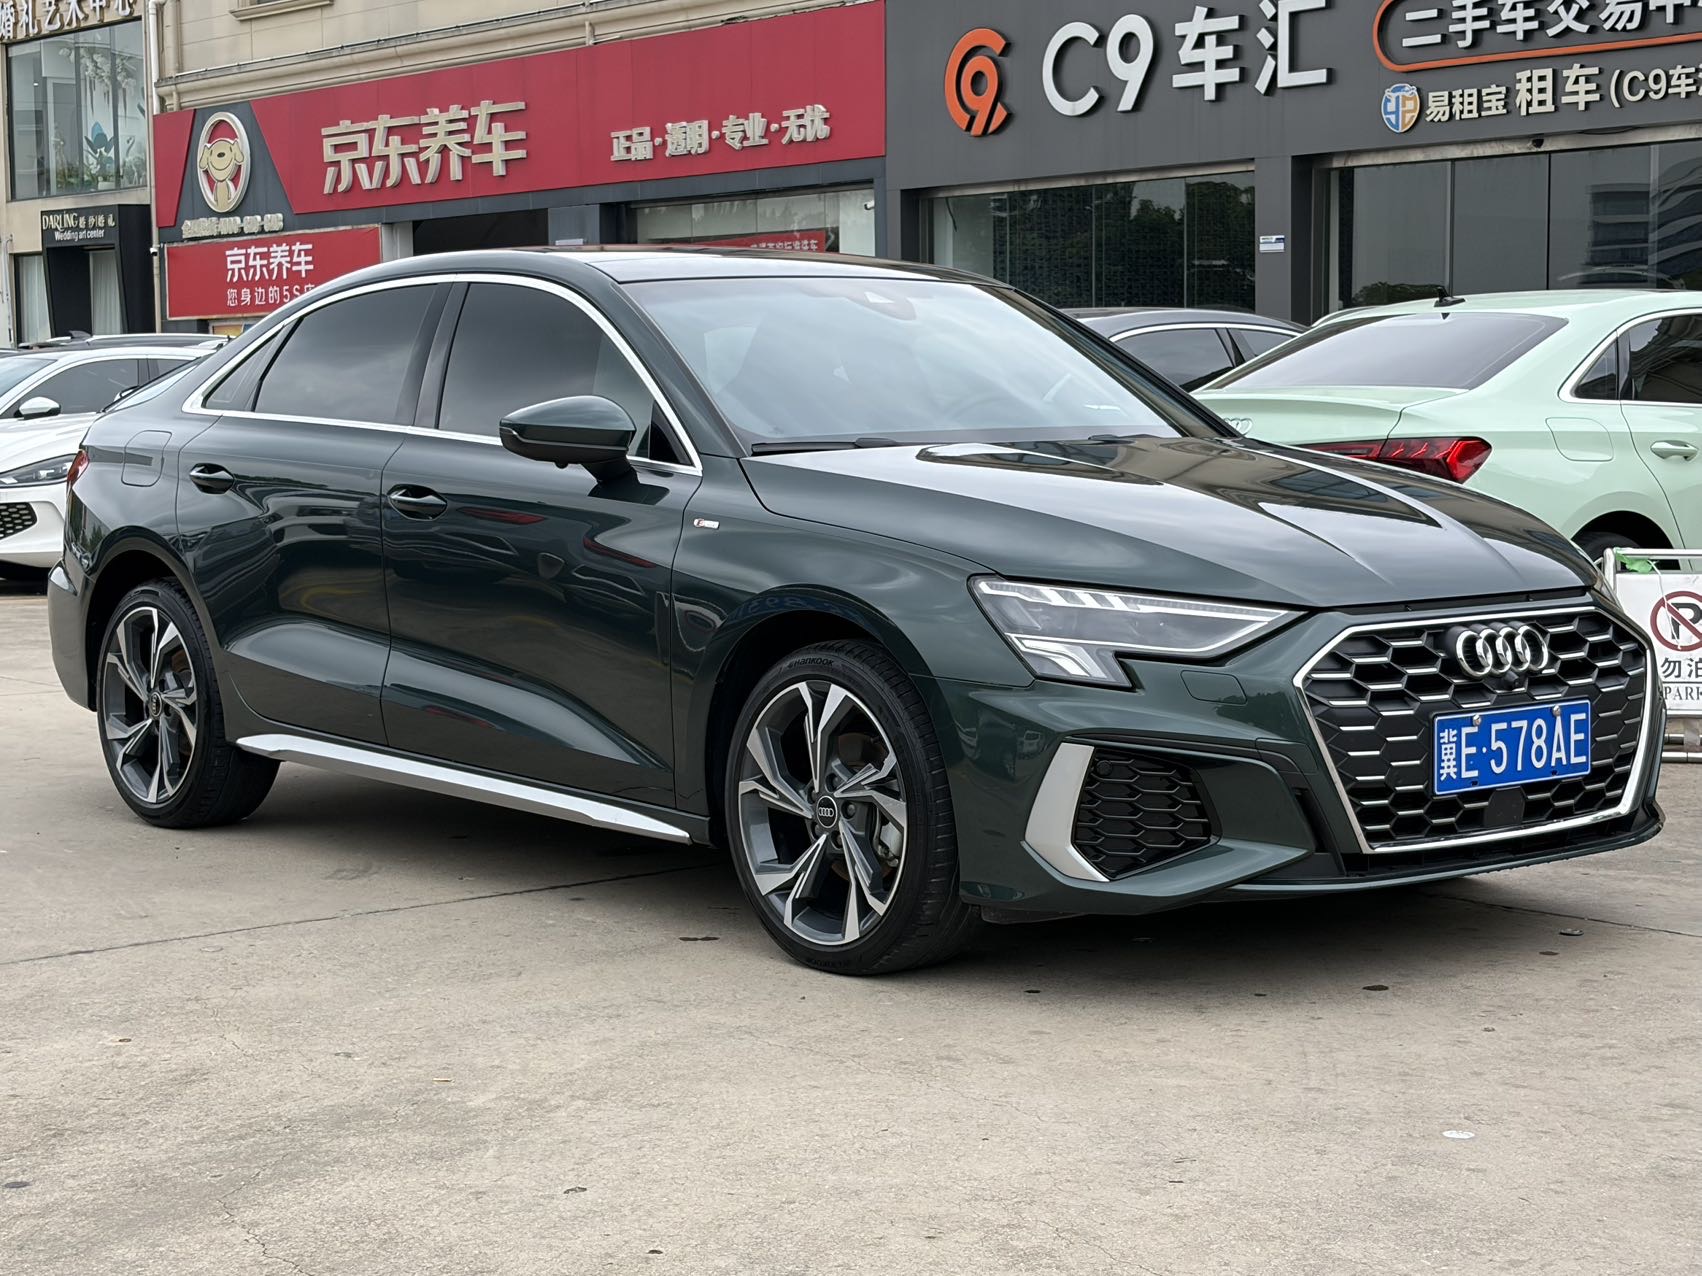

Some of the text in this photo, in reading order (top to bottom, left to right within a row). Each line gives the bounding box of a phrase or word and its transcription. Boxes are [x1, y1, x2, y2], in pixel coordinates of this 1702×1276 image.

[1425, 63, 1702, 122] 易租宝 租车 (C9车
[321, 100, 527, 194] 京东养车
[54, 229, 105, 241] Wedding art center
[225, 242, 314, 282] 京东养车
